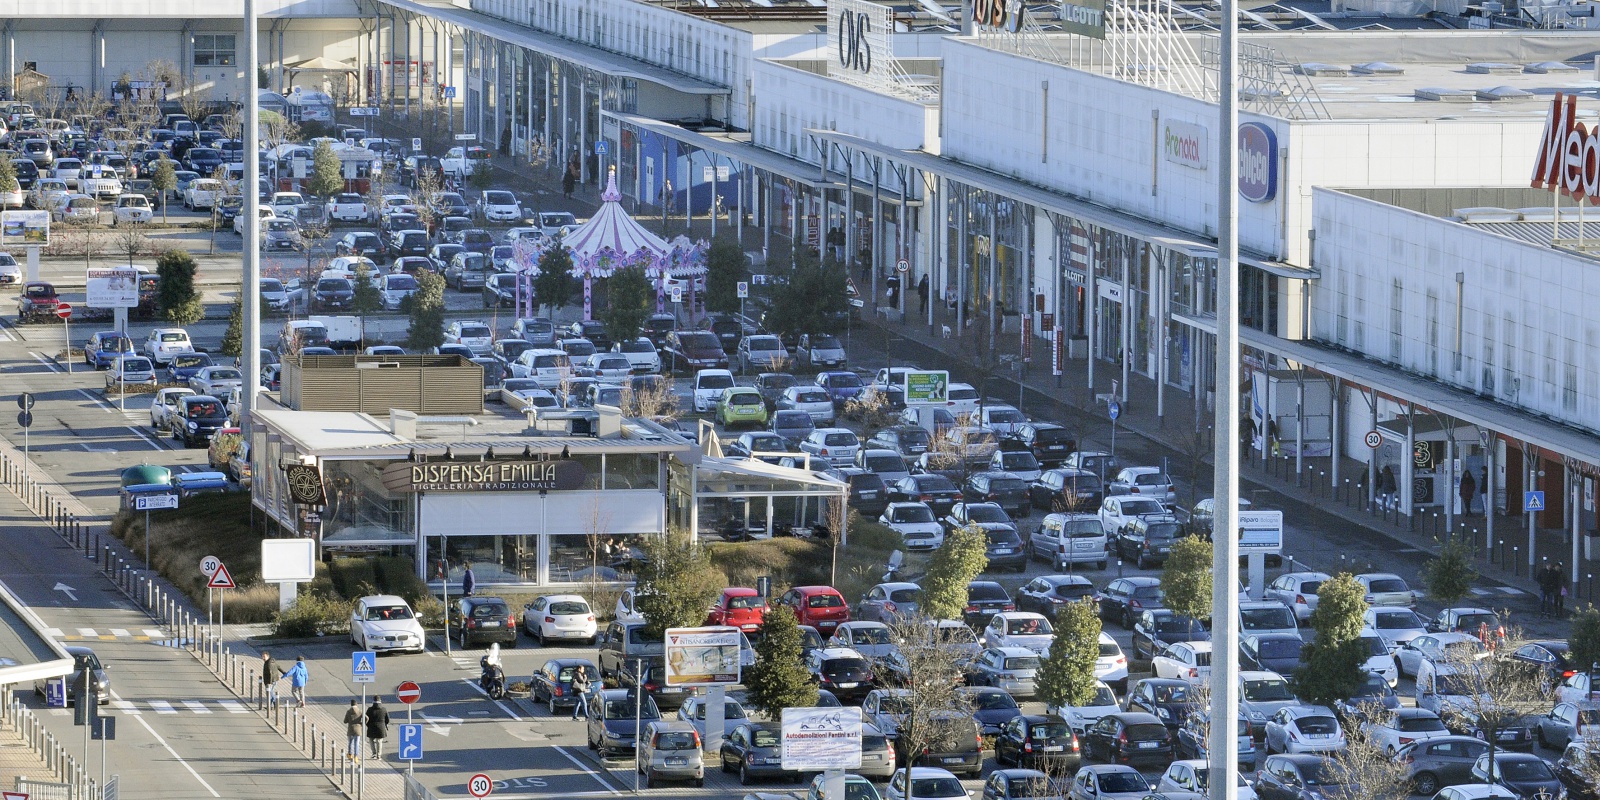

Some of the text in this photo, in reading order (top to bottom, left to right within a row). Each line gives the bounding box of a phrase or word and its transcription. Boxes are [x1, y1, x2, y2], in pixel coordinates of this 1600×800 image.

[1060, 3, 1101, 27] ALCOTT
[839, 8, 871, 74] OVS
[898, 262, 907, 270] 30
[1064, 269, 1084, 283] ALCOTT
[1368, 435, 1379, 444] 30
[412, 464, 556, 483] DISPENSA EMILIA
[205, 561, 216, 571] 30
[405, 725, 417, 742] P
[473, 780, 487, 791] 30
